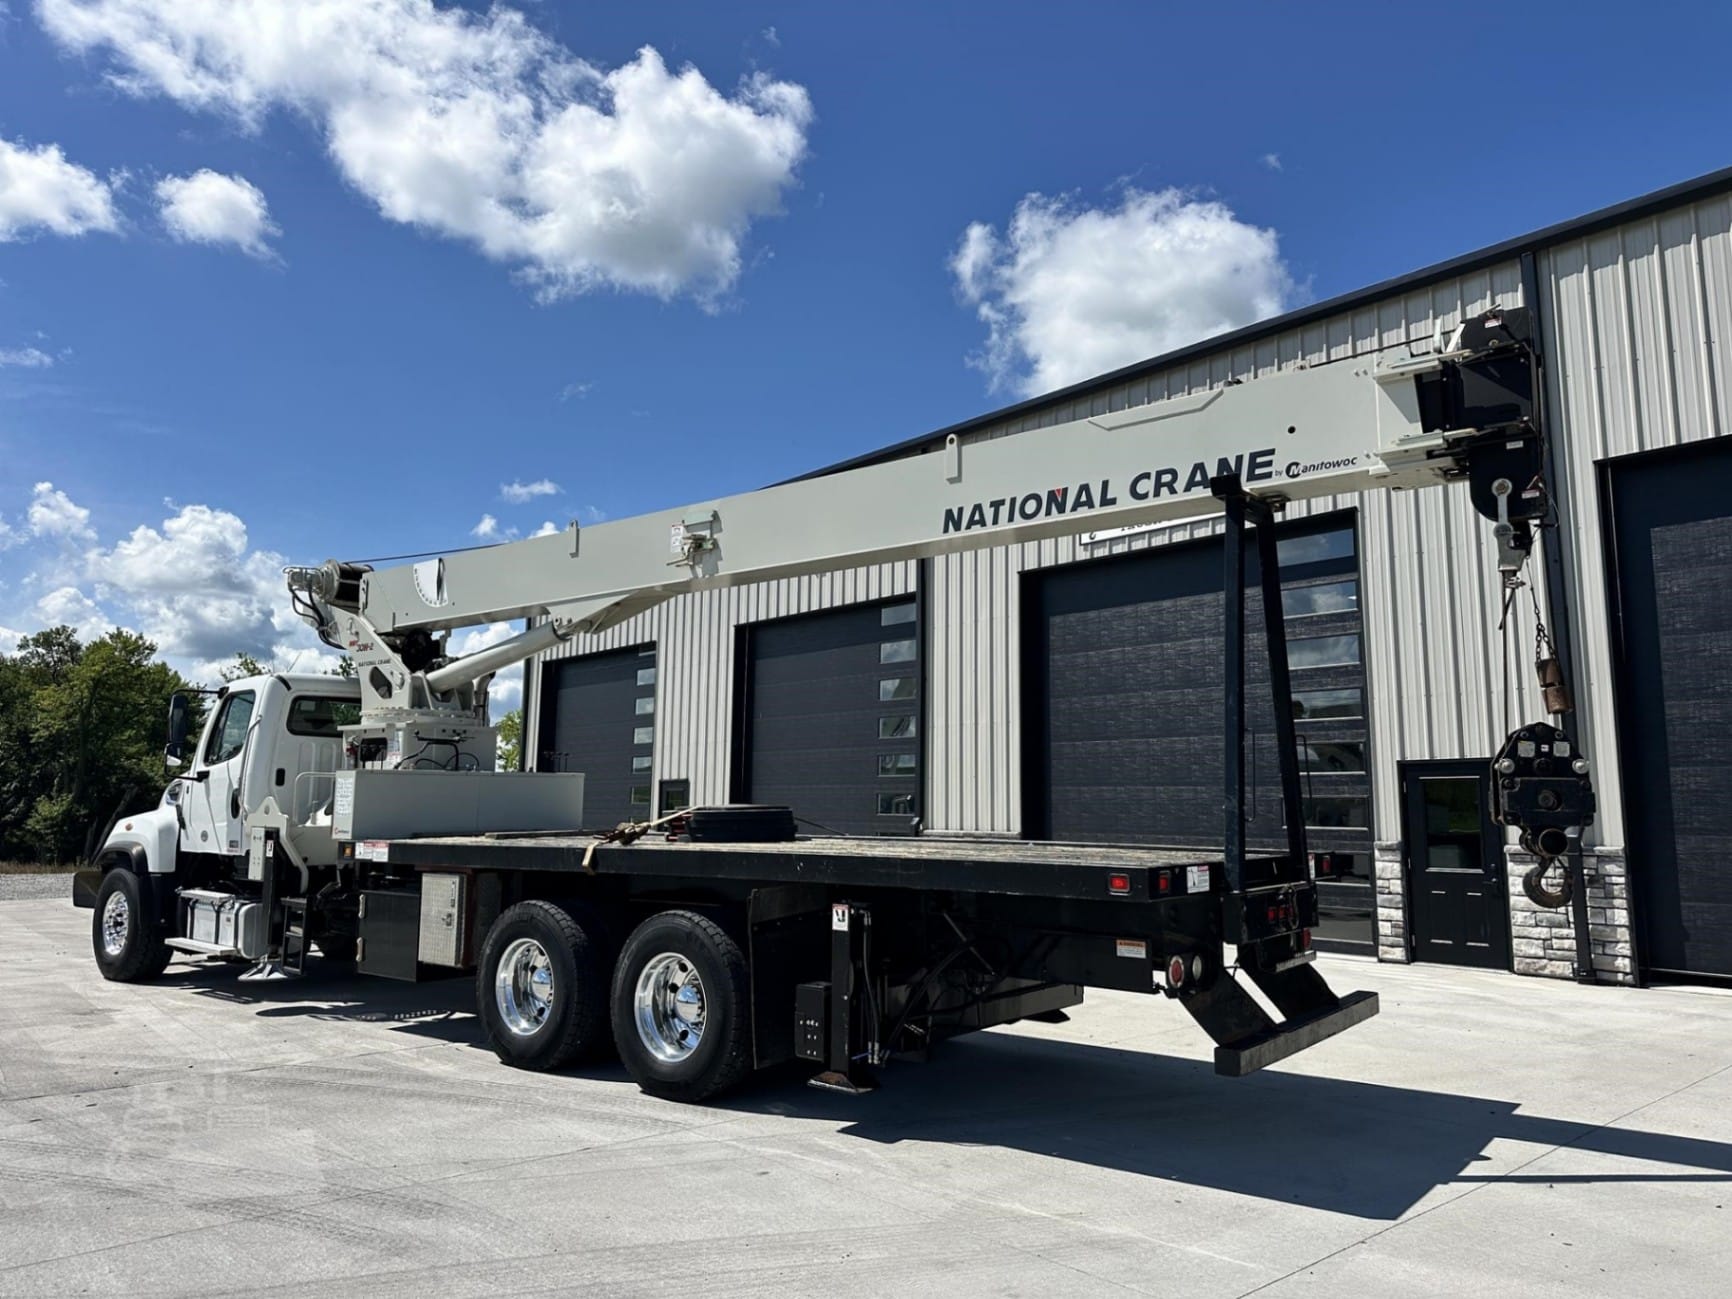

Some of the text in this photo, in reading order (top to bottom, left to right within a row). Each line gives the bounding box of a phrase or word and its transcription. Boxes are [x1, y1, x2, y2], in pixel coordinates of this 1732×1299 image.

[943, 448, 1358, 534] NATIONAL CRANE by Manitowoc
